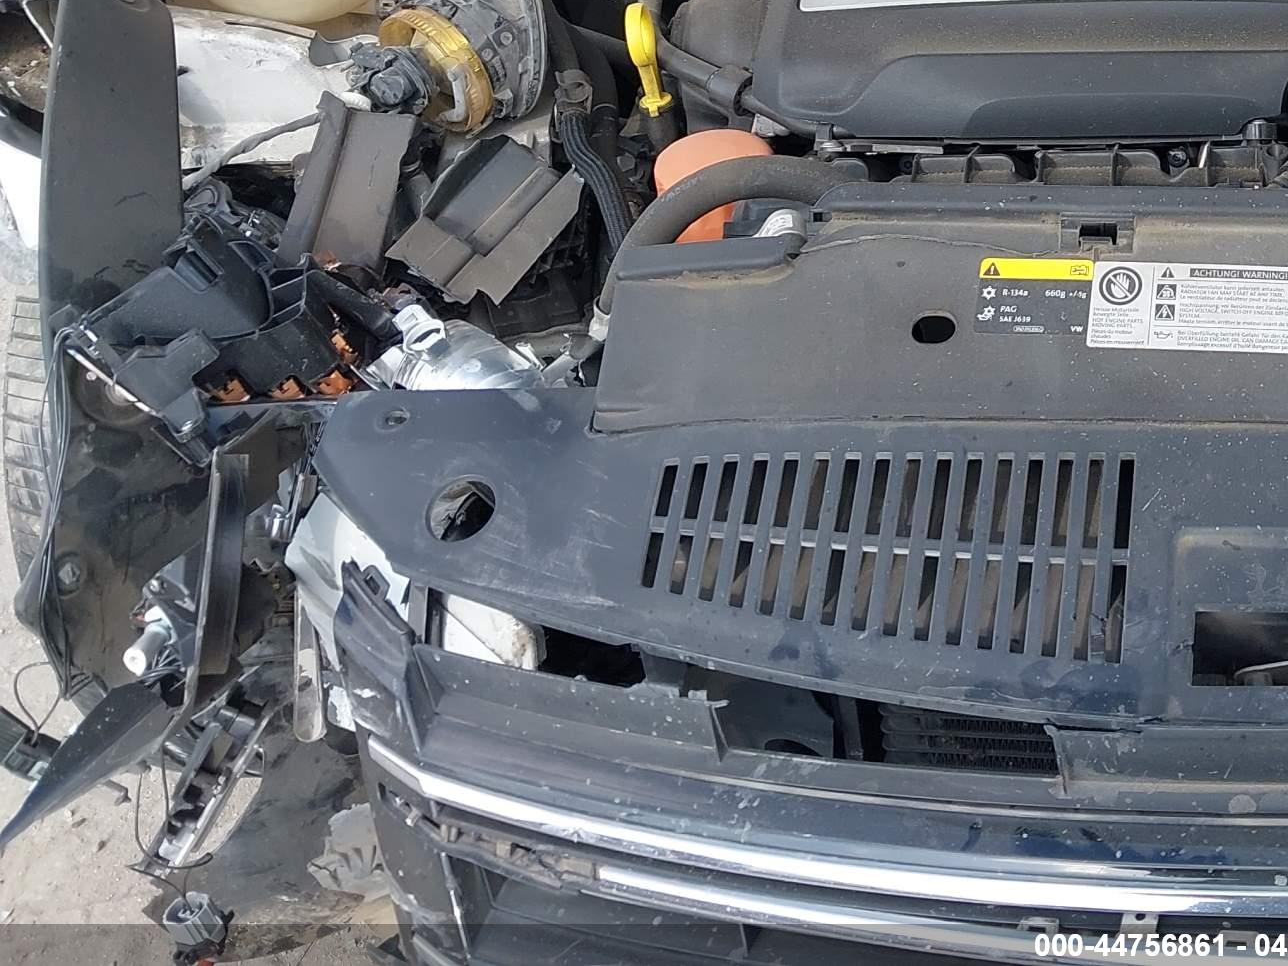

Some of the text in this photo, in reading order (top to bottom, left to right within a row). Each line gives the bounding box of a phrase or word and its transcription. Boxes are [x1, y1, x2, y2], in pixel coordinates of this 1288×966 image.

[1194, 269, 1239, 278] ACHTUNG!
[1242, 271, 1288, 280] WARNING!
[1002, 288, 1029, 297] R-134a
[1000, 305, 1017, 313] PAG
[999, 315, 1031, 323] SAE J639
[1070, 325, 1084, 333] VW
